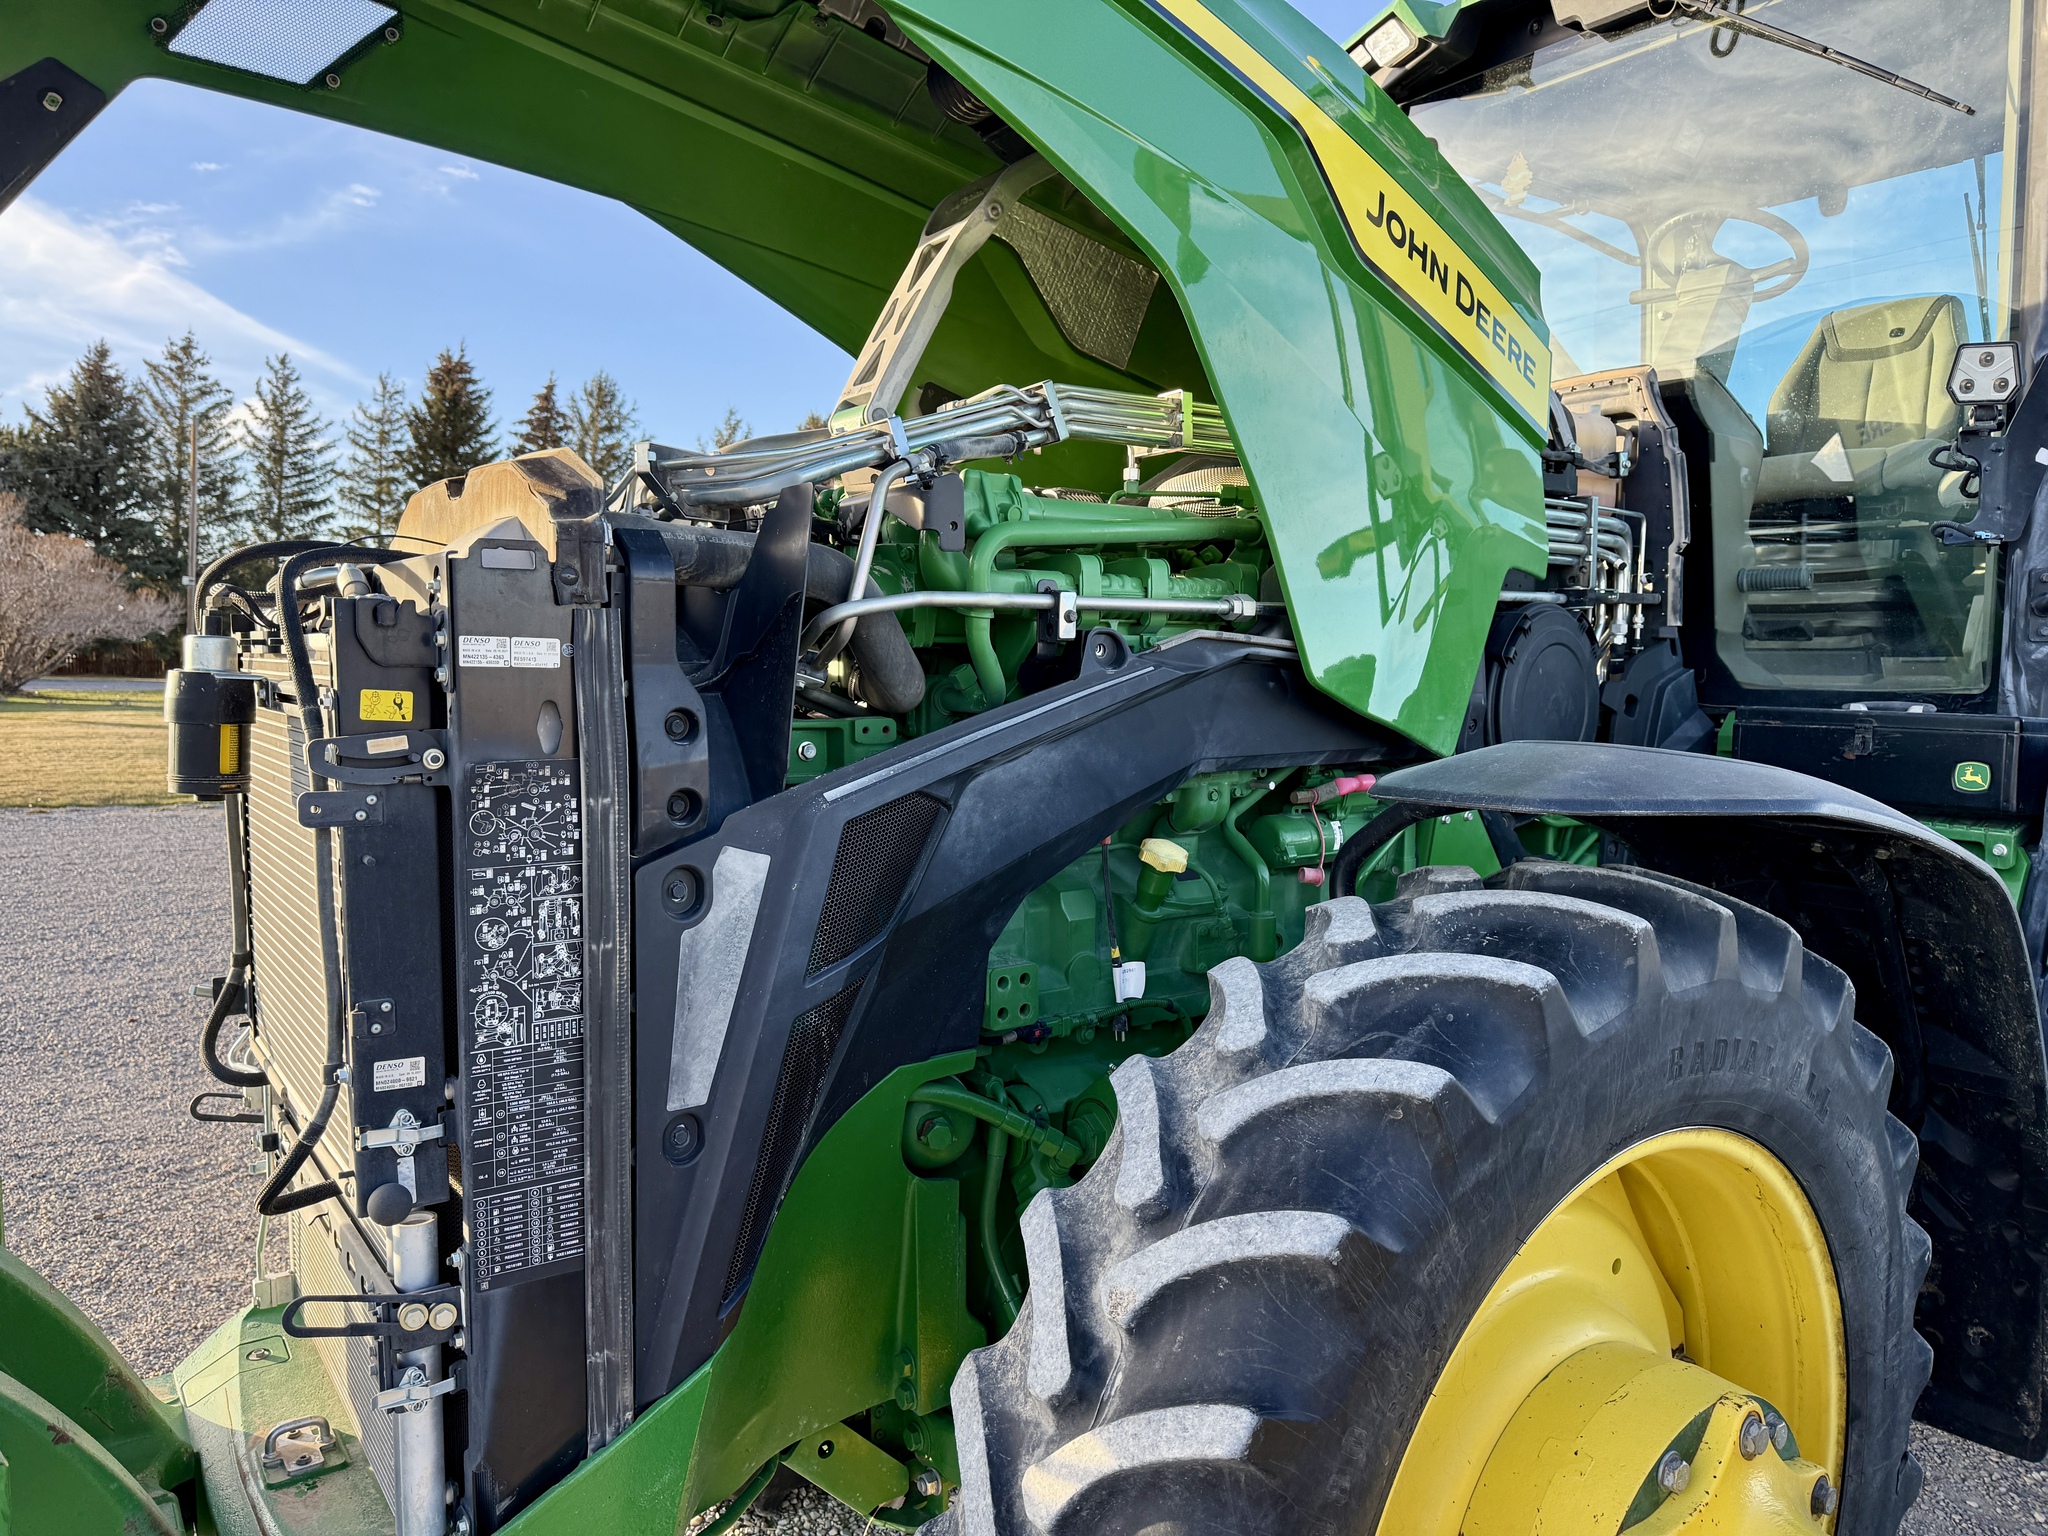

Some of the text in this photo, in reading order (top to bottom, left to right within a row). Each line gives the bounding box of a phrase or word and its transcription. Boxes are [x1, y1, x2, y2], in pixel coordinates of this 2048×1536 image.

[1366, 190, 1537, 390] JOHN DEERE
[376, 1062, 404, 1070] DENSO
[1666, 1037, 1778, 1085] RADIAL
[1786, 1060, 1831, 1124] ALL
